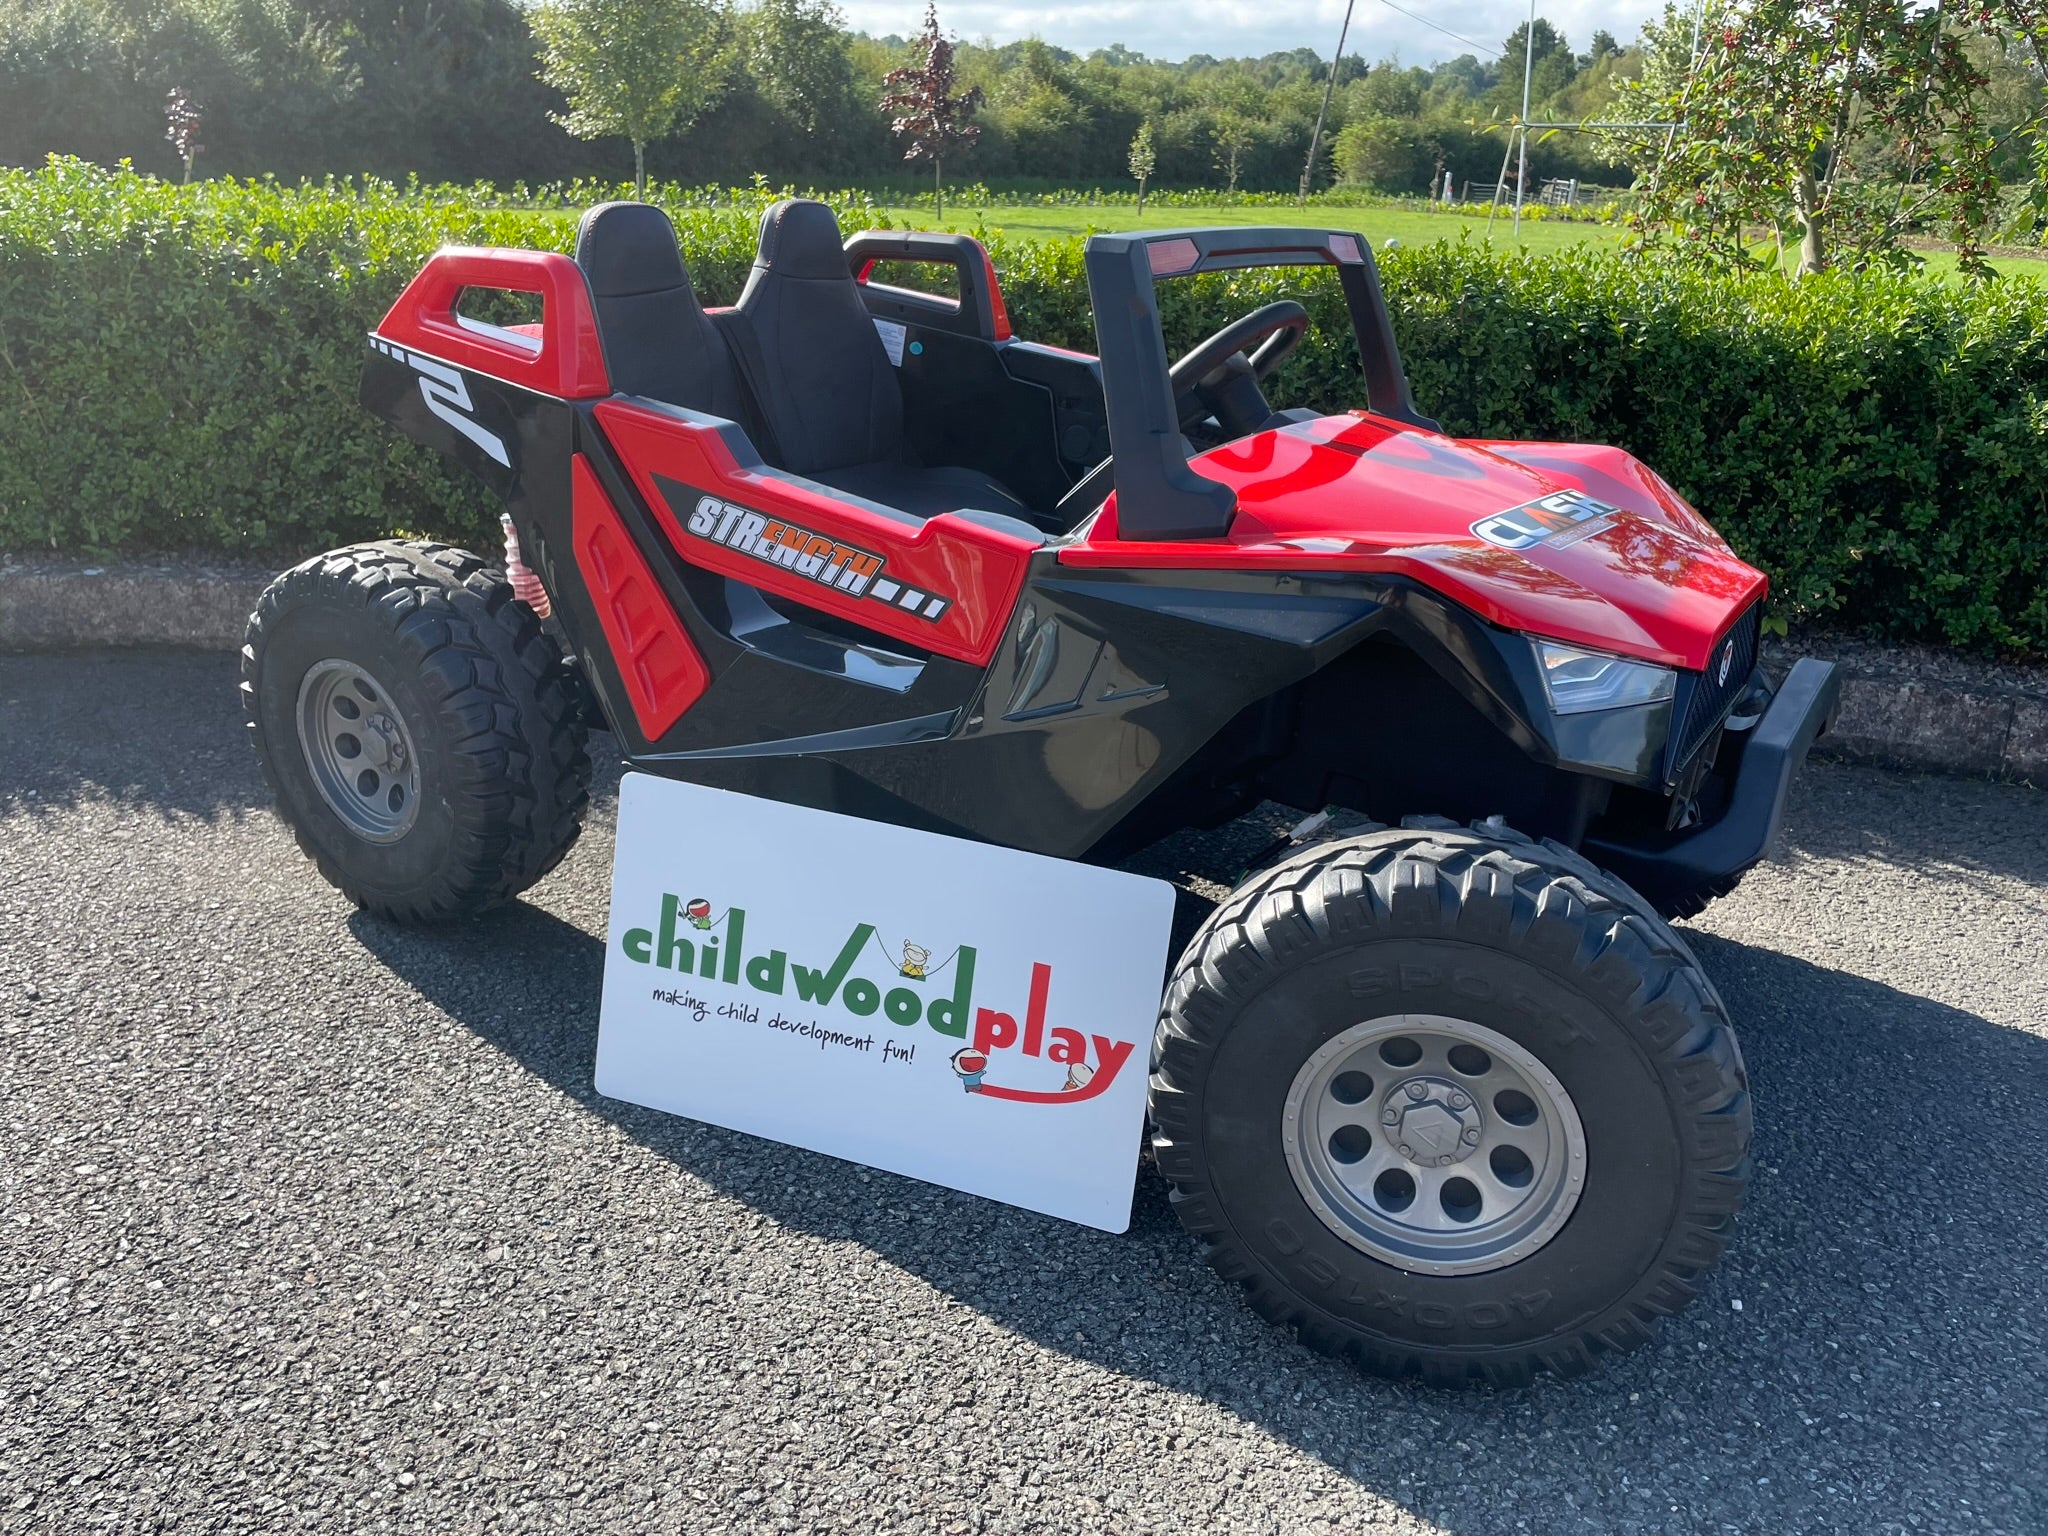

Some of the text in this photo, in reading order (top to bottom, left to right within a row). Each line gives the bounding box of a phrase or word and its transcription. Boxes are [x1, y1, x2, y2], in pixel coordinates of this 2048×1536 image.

[688, 496, 885, 597] STRENGTH
[1475, 491, 1613, 548] CLASH
[652, 987, 915, 1064] making child development fun!
[1346, 961, 1600, 1047] SPORT
